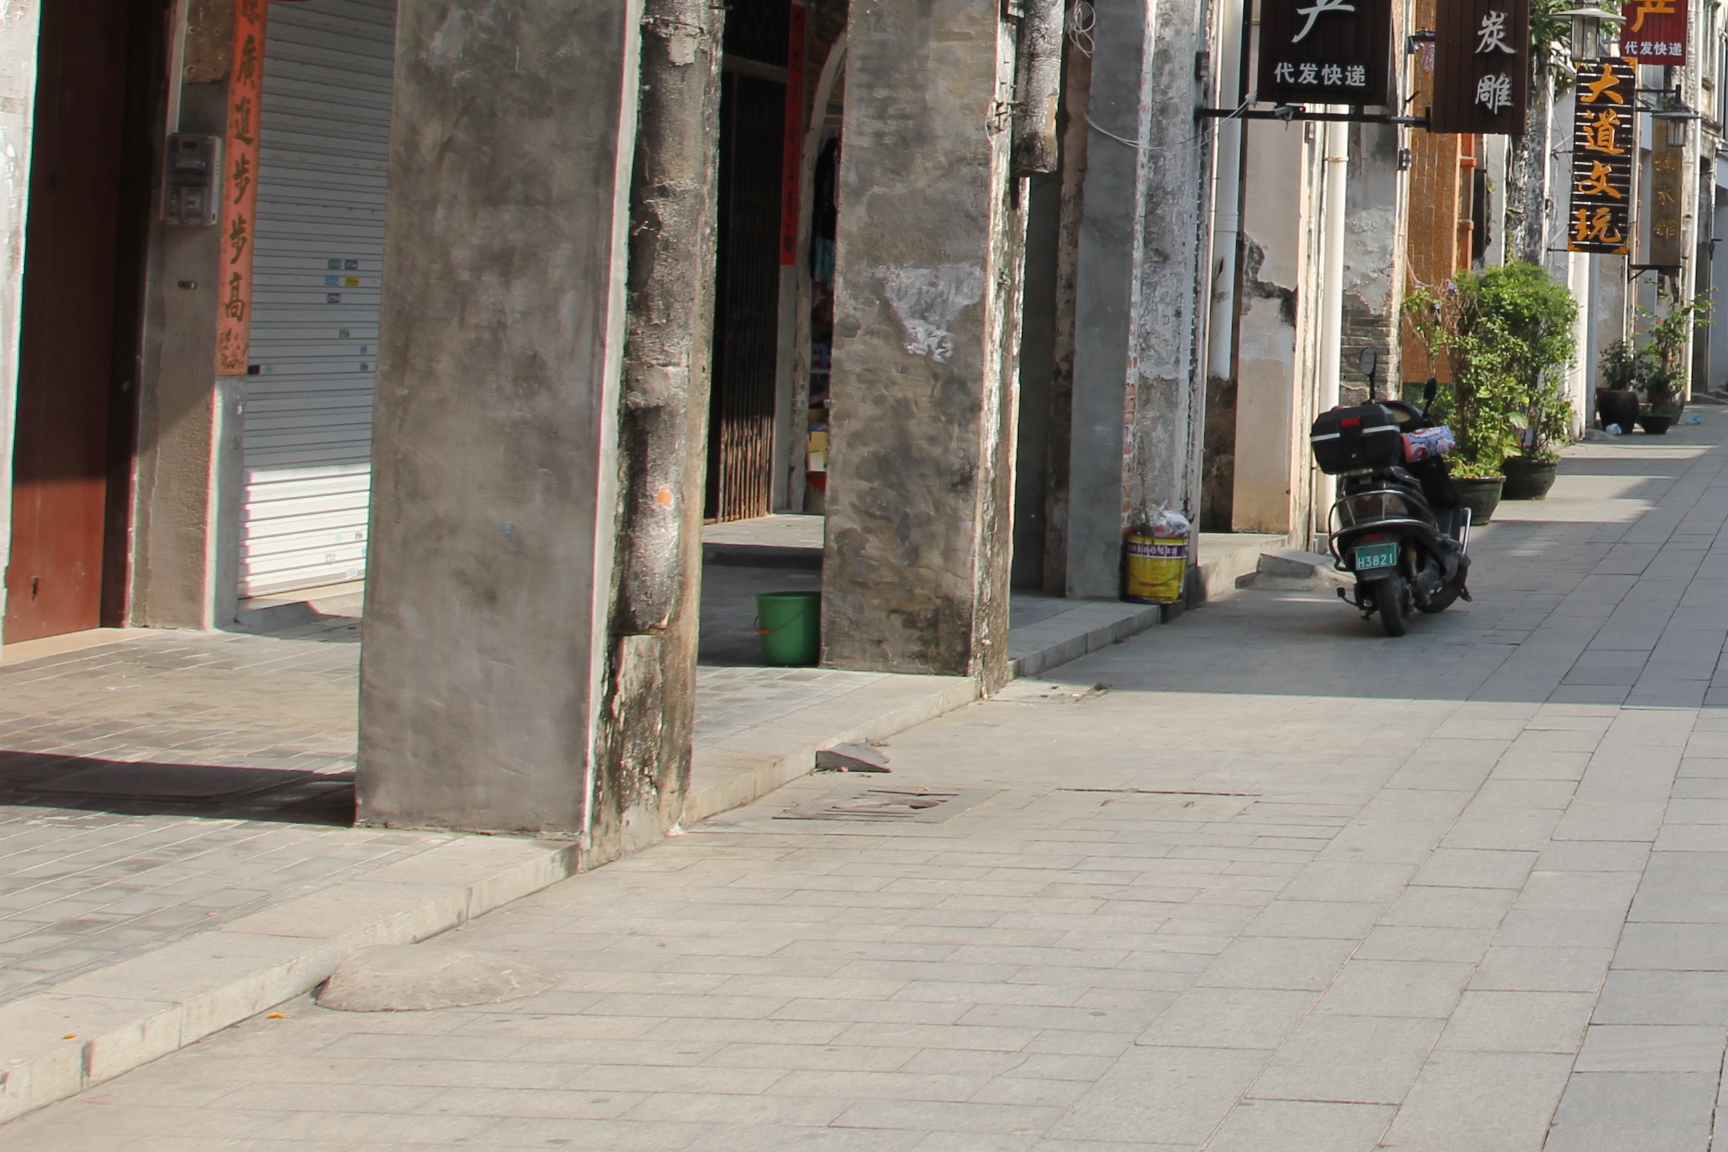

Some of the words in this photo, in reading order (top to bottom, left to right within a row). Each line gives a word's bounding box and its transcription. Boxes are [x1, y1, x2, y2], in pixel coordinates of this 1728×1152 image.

[1625, 41, 1683, 57] 代发快递
[1274, 62, 1367, 87] 代发快递
[1574, 63, 1625, 244] 大道文玩
[1358, 553, 1393, 568] H3821
